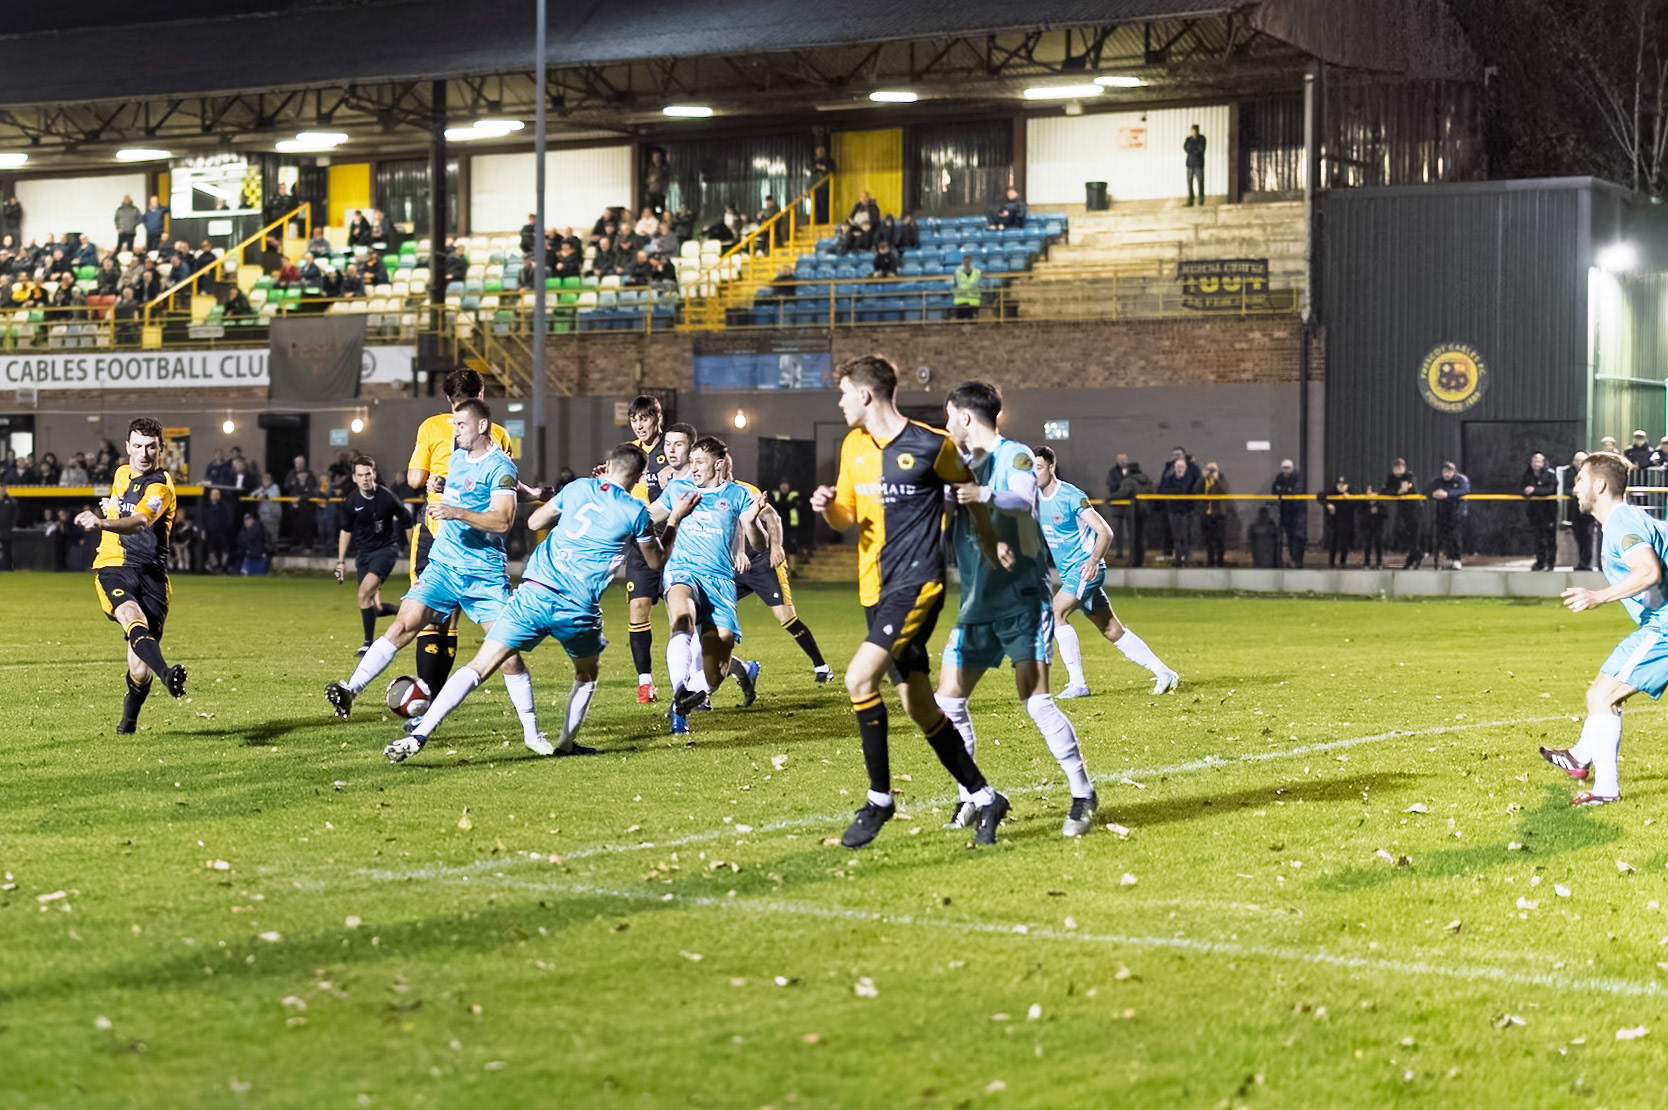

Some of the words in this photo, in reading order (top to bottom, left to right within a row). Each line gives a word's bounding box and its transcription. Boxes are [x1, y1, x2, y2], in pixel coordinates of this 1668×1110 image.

[6, 360, 88, 382] CABLES
[95, 356, 213, 381] FOOTBALL
[565, 502, 604, 540] 5
